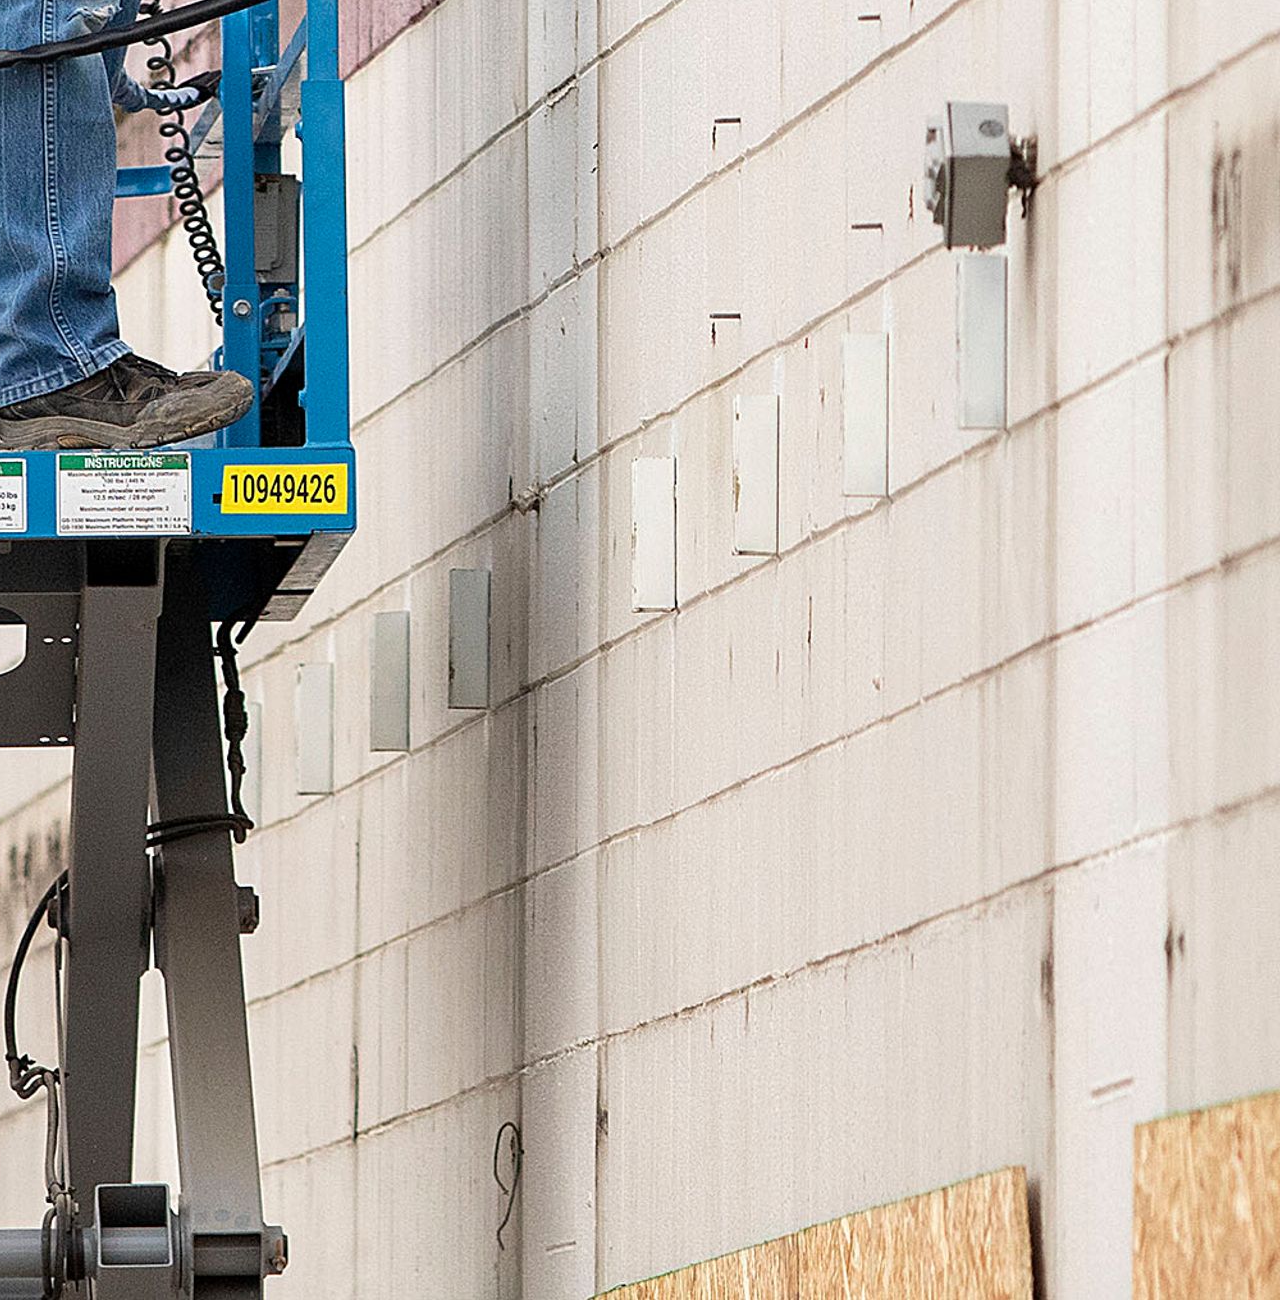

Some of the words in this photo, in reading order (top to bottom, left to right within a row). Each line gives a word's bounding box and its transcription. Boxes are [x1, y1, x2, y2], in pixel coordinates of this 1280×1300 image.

[84, 457, 163, 468] INSTRUCTIONS
[231, 474, 336, 504] 10949426
[7, 503, 16, 511] kg
